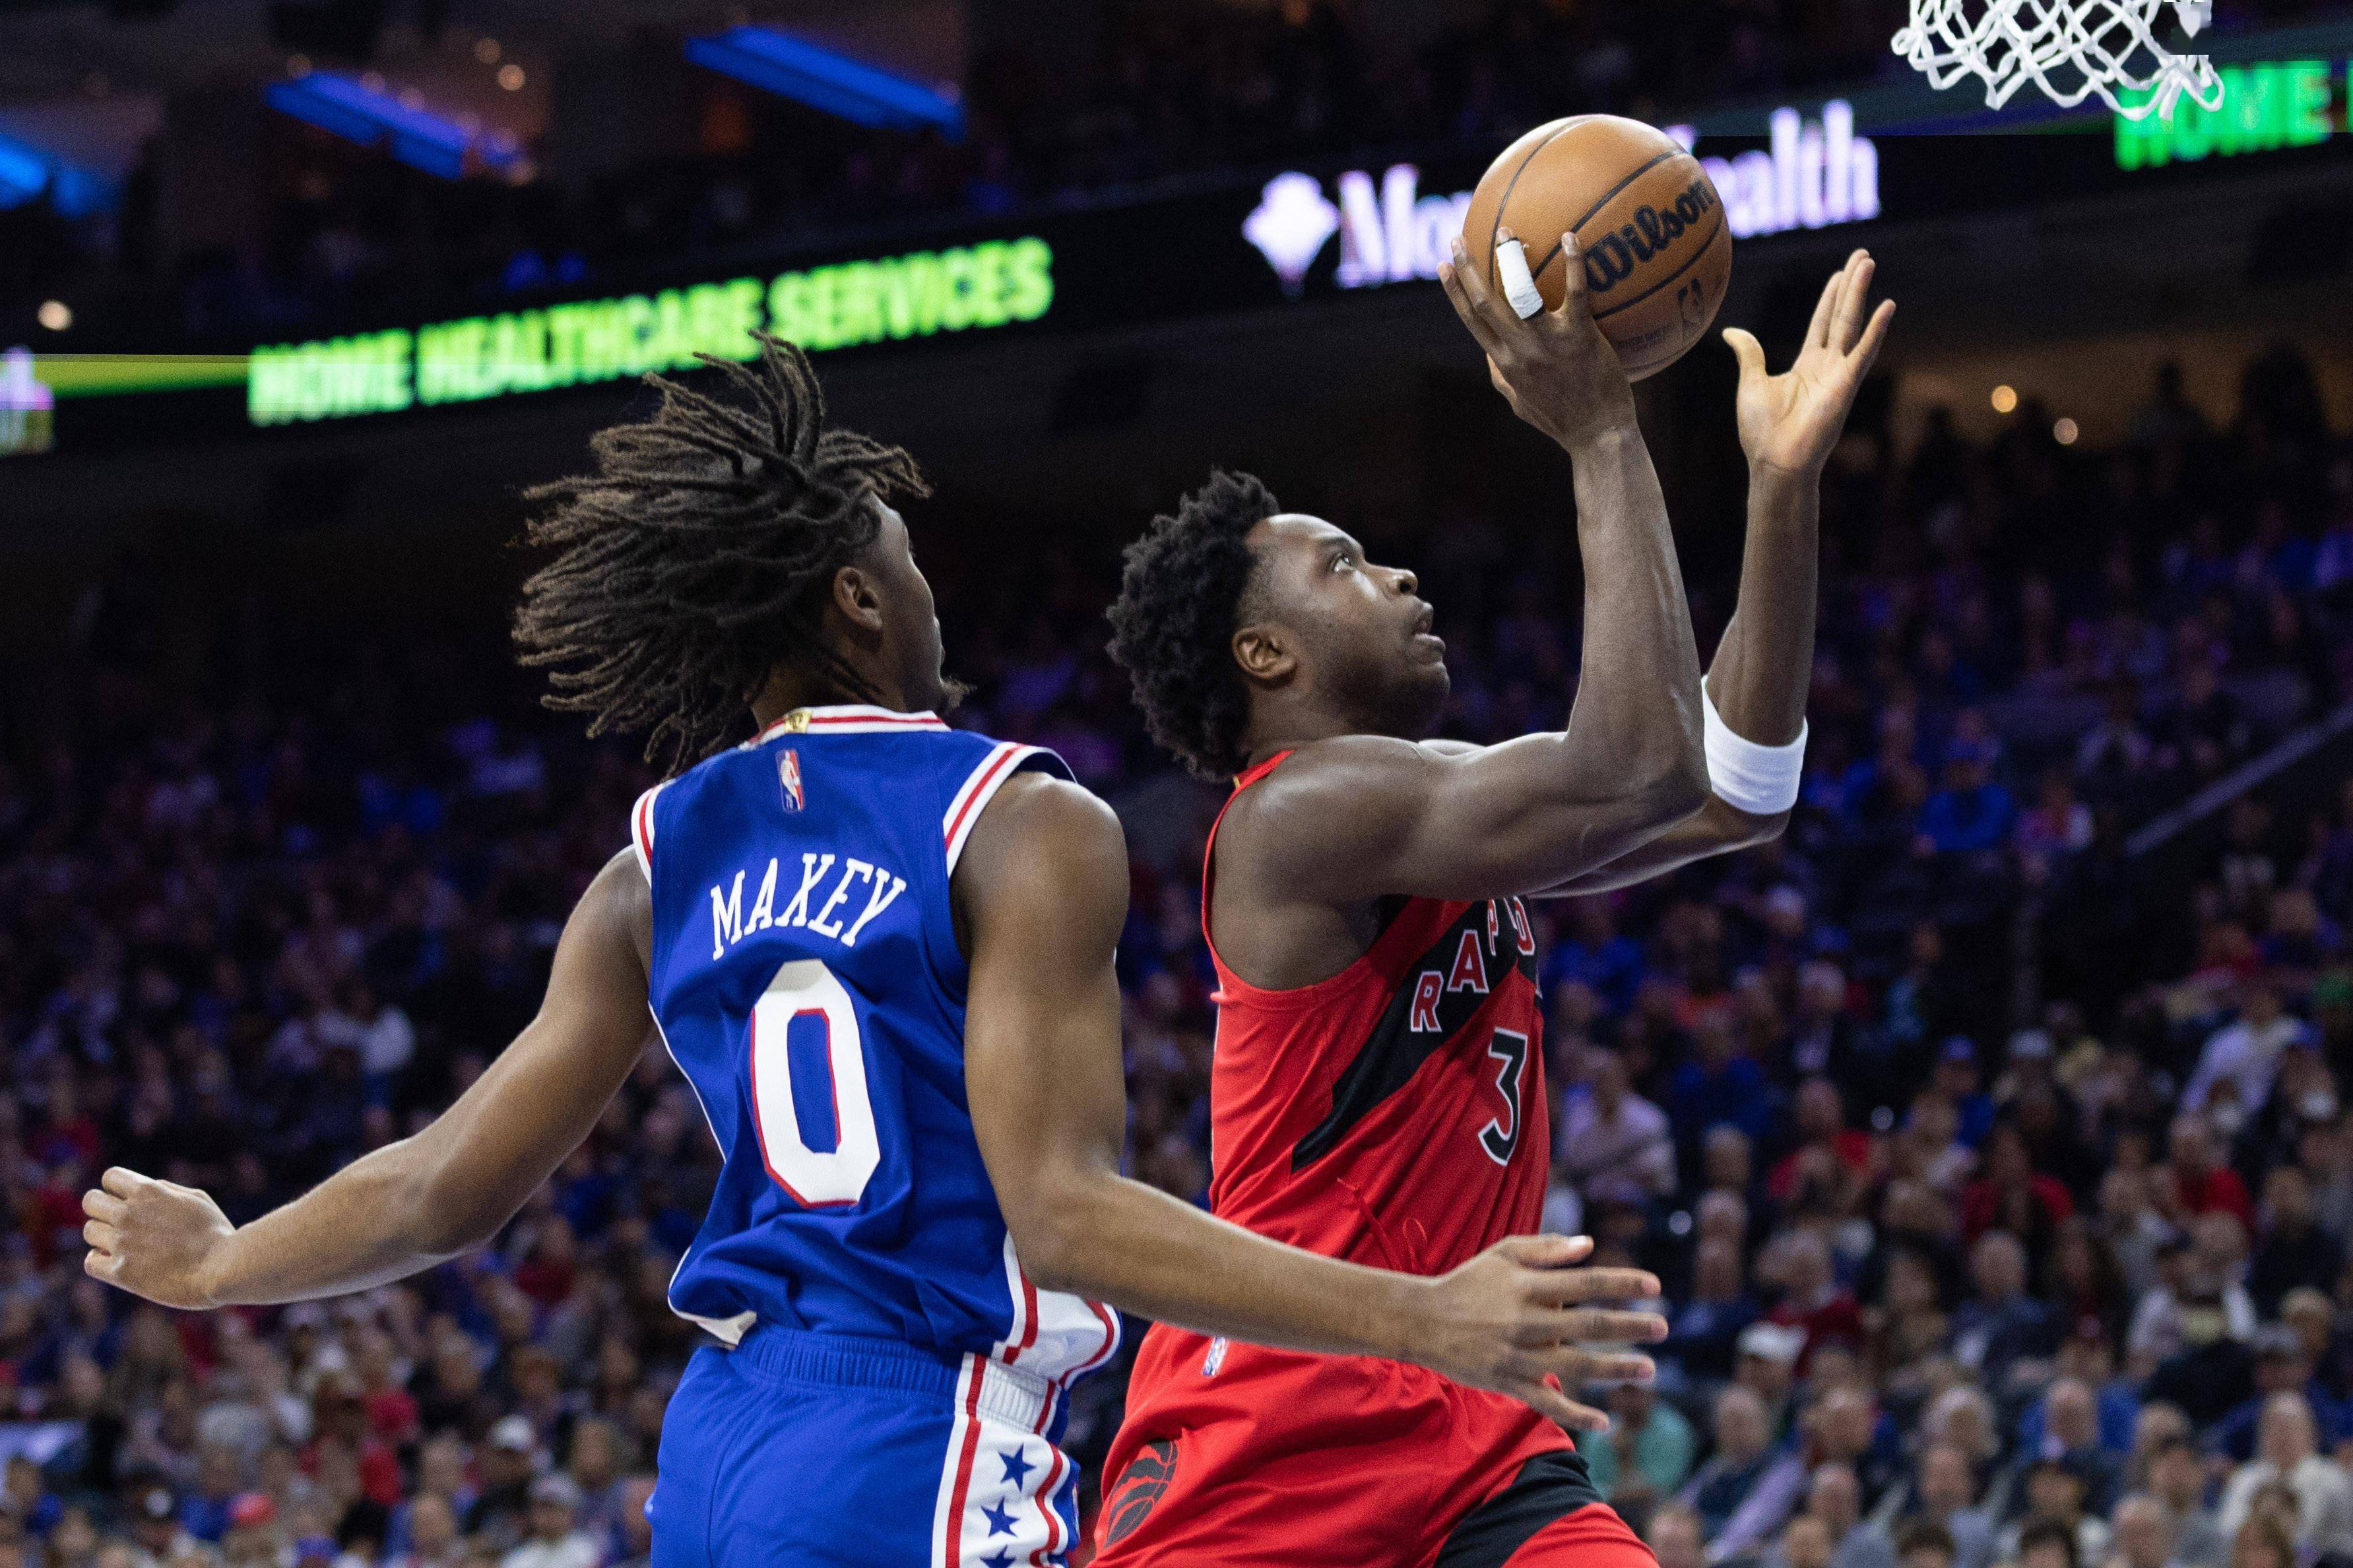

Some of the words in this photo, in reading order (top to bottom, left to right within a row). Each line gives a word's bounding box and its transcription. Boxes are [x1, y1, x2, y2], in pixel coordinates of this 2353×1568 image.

[1584, 180, 1716, 292] Wilson
[247, 328, 414, 427] HOME
[416, 276, 764, 407] HEALTHCARE
[767, 235, 1054, 352] SERVICES
[710, 852, 907, 961] MAXEY
[750, 958, 881, 1209] 0
[1477, 1026, 1528, 1167] 3
